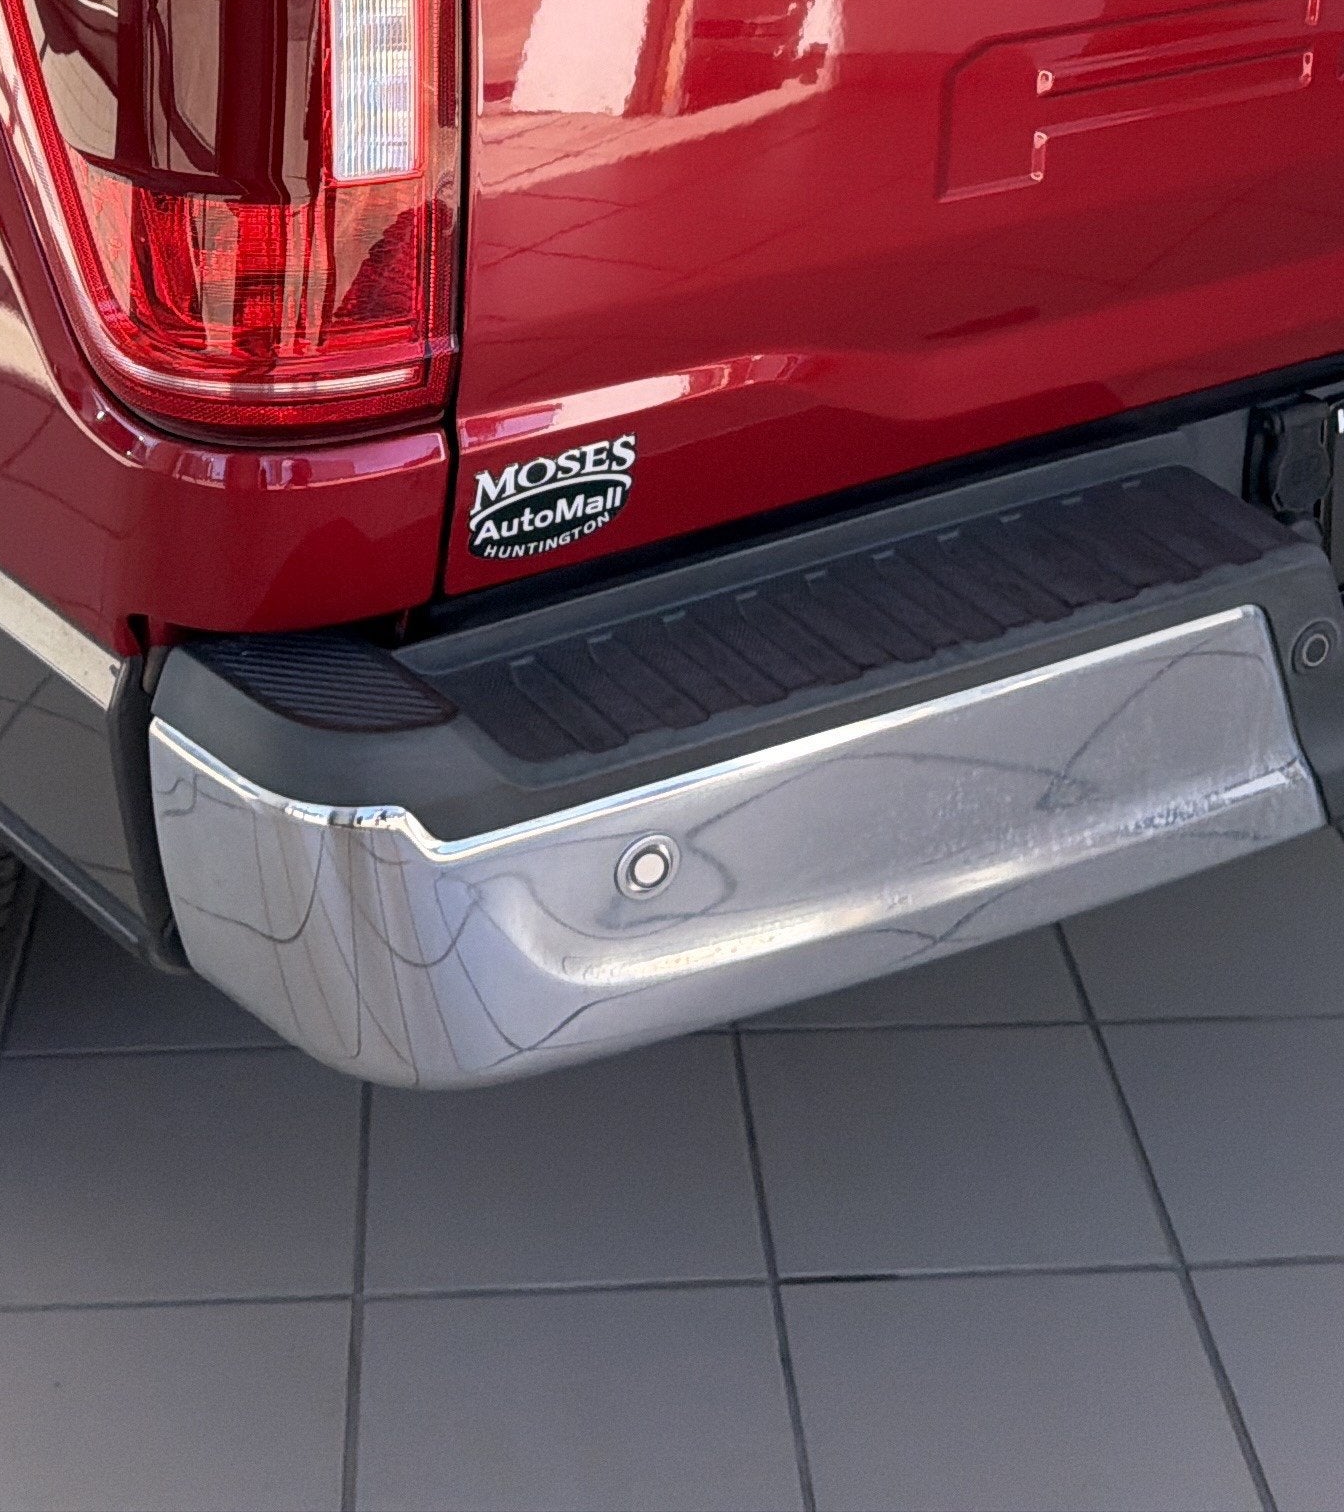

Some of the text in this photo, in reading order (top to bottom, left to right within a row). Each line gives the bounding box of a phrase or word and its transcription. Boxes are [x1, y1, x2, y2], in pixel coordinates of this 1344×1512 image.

[469, 432, 637, 517] MOSES
[473, 486, 624, 546] AutoMall
[483, 511, 611, 559] HUNTINGTON
